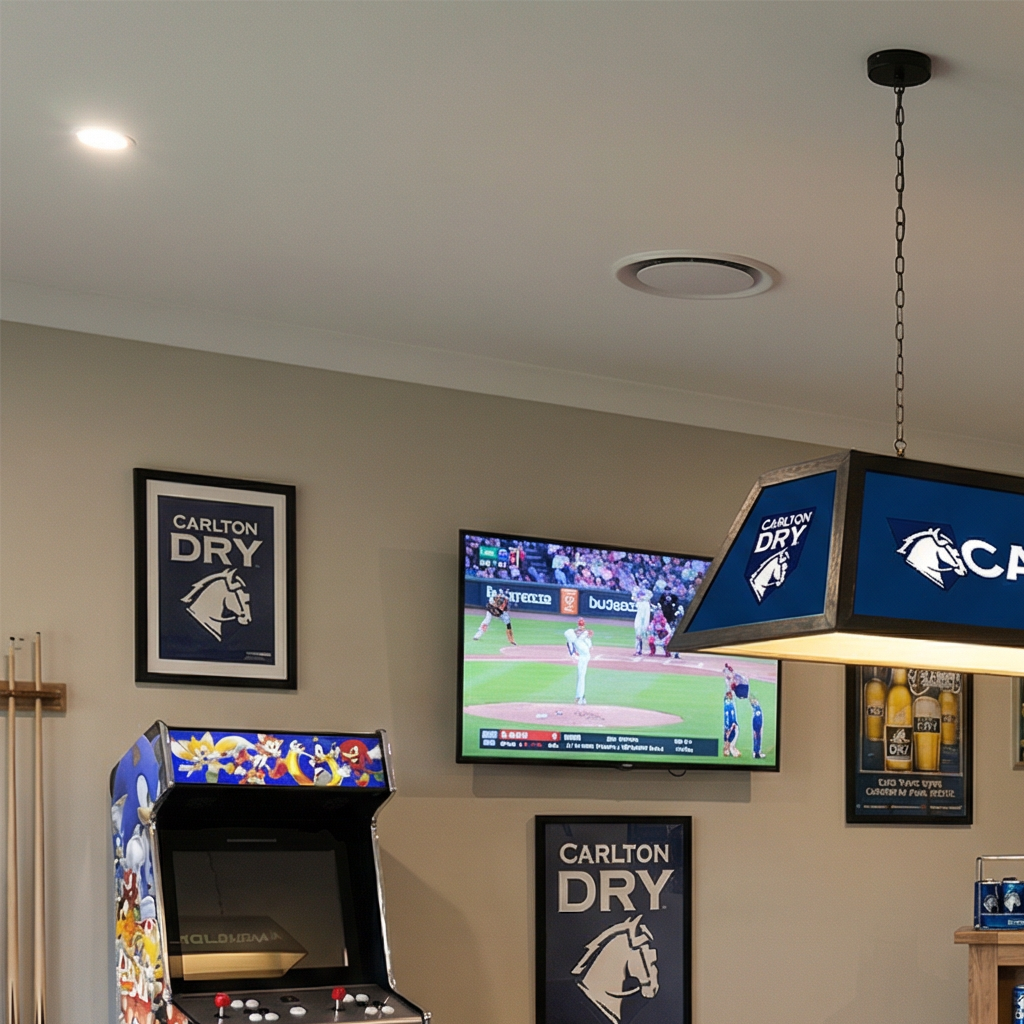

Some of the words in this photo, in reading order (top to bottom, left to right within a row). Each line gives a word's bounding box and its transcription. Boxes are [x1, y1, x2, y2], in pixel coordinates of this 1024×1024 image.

[173, 514, 257, 536] CARLTON
[761, 511, 813, 531] CARLTON
[170, 532, 263, 567] DRY
[753, 524, 807, 554] DRY
[559, 842, 669, 865] CARLTON
[558, 869, 674, 913] DRY
